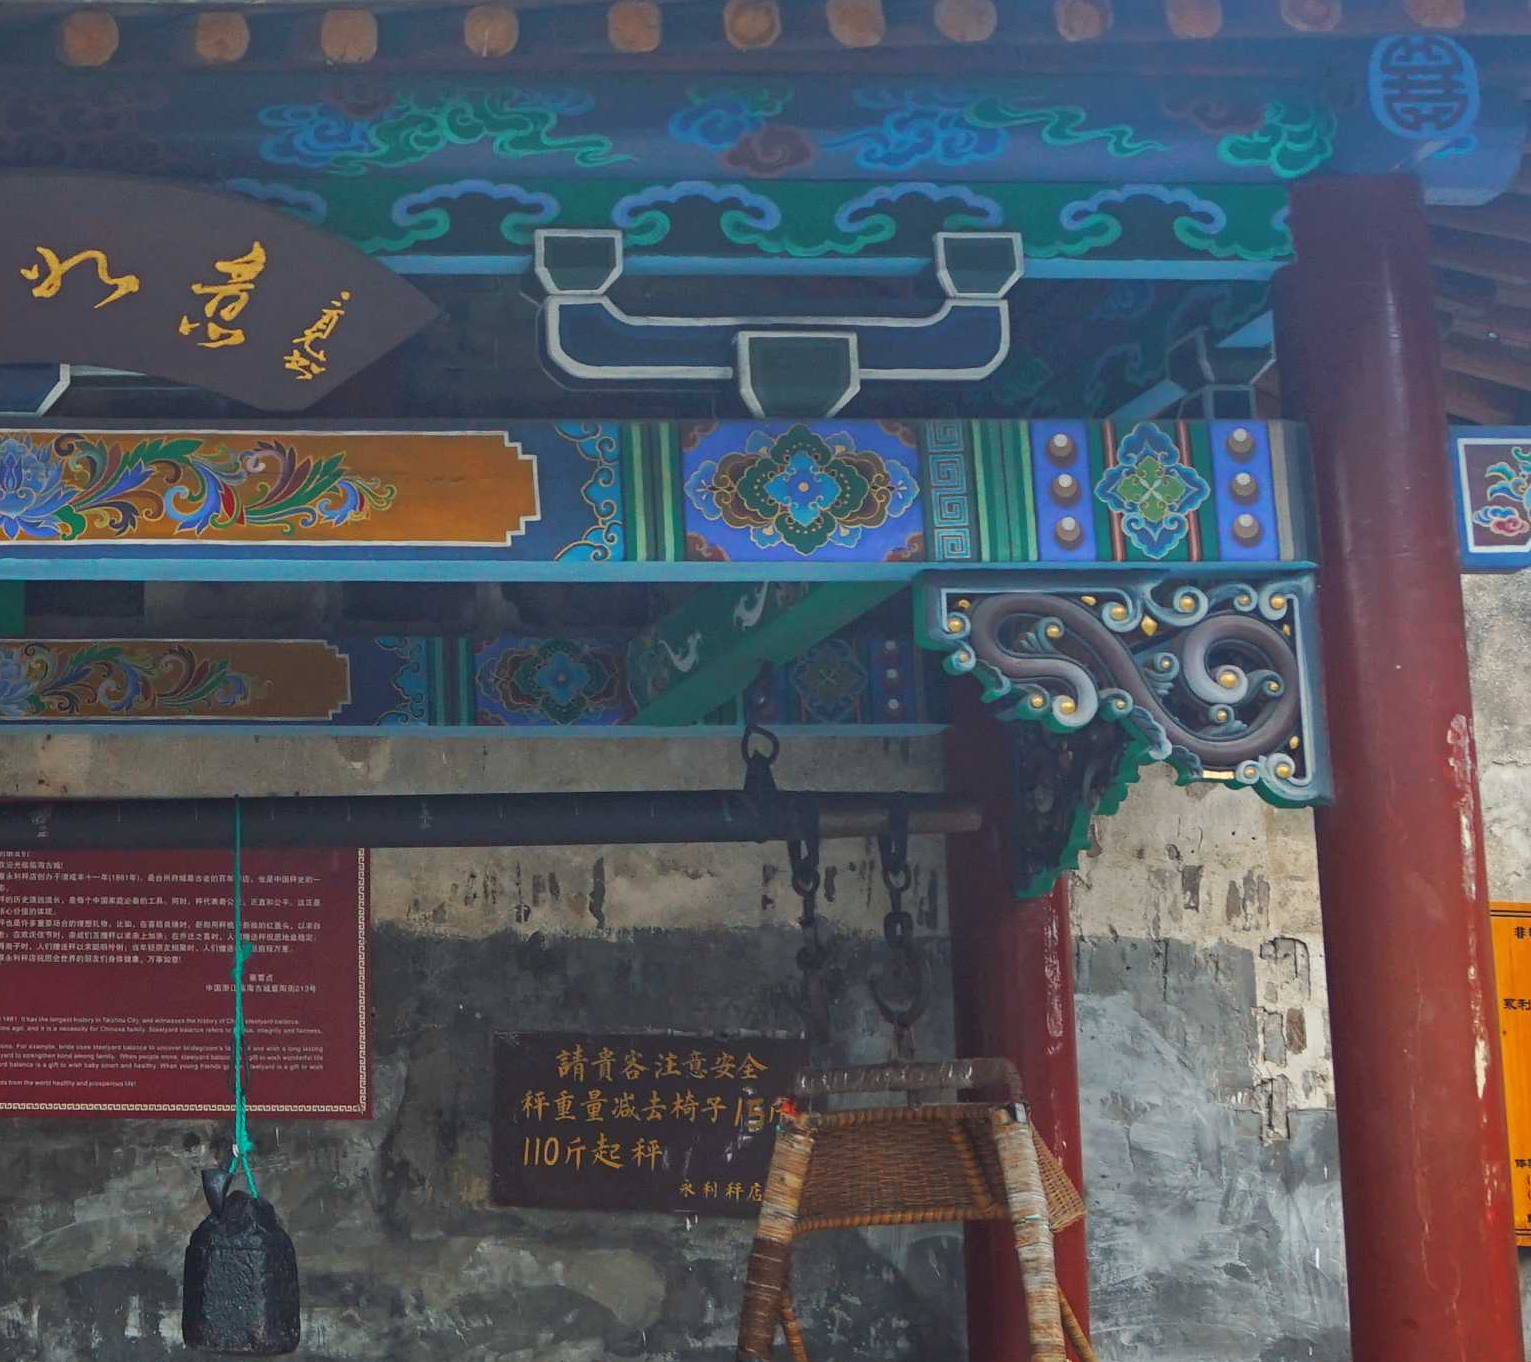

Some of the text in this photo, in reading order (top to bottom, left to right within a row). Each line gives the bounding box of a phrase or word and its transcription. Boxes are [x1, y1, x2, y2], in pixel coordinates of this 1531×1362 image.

[523, 1133, 664, 1171] 110斤起秤
[678, 1180, 764, 1202] 永利秤店
